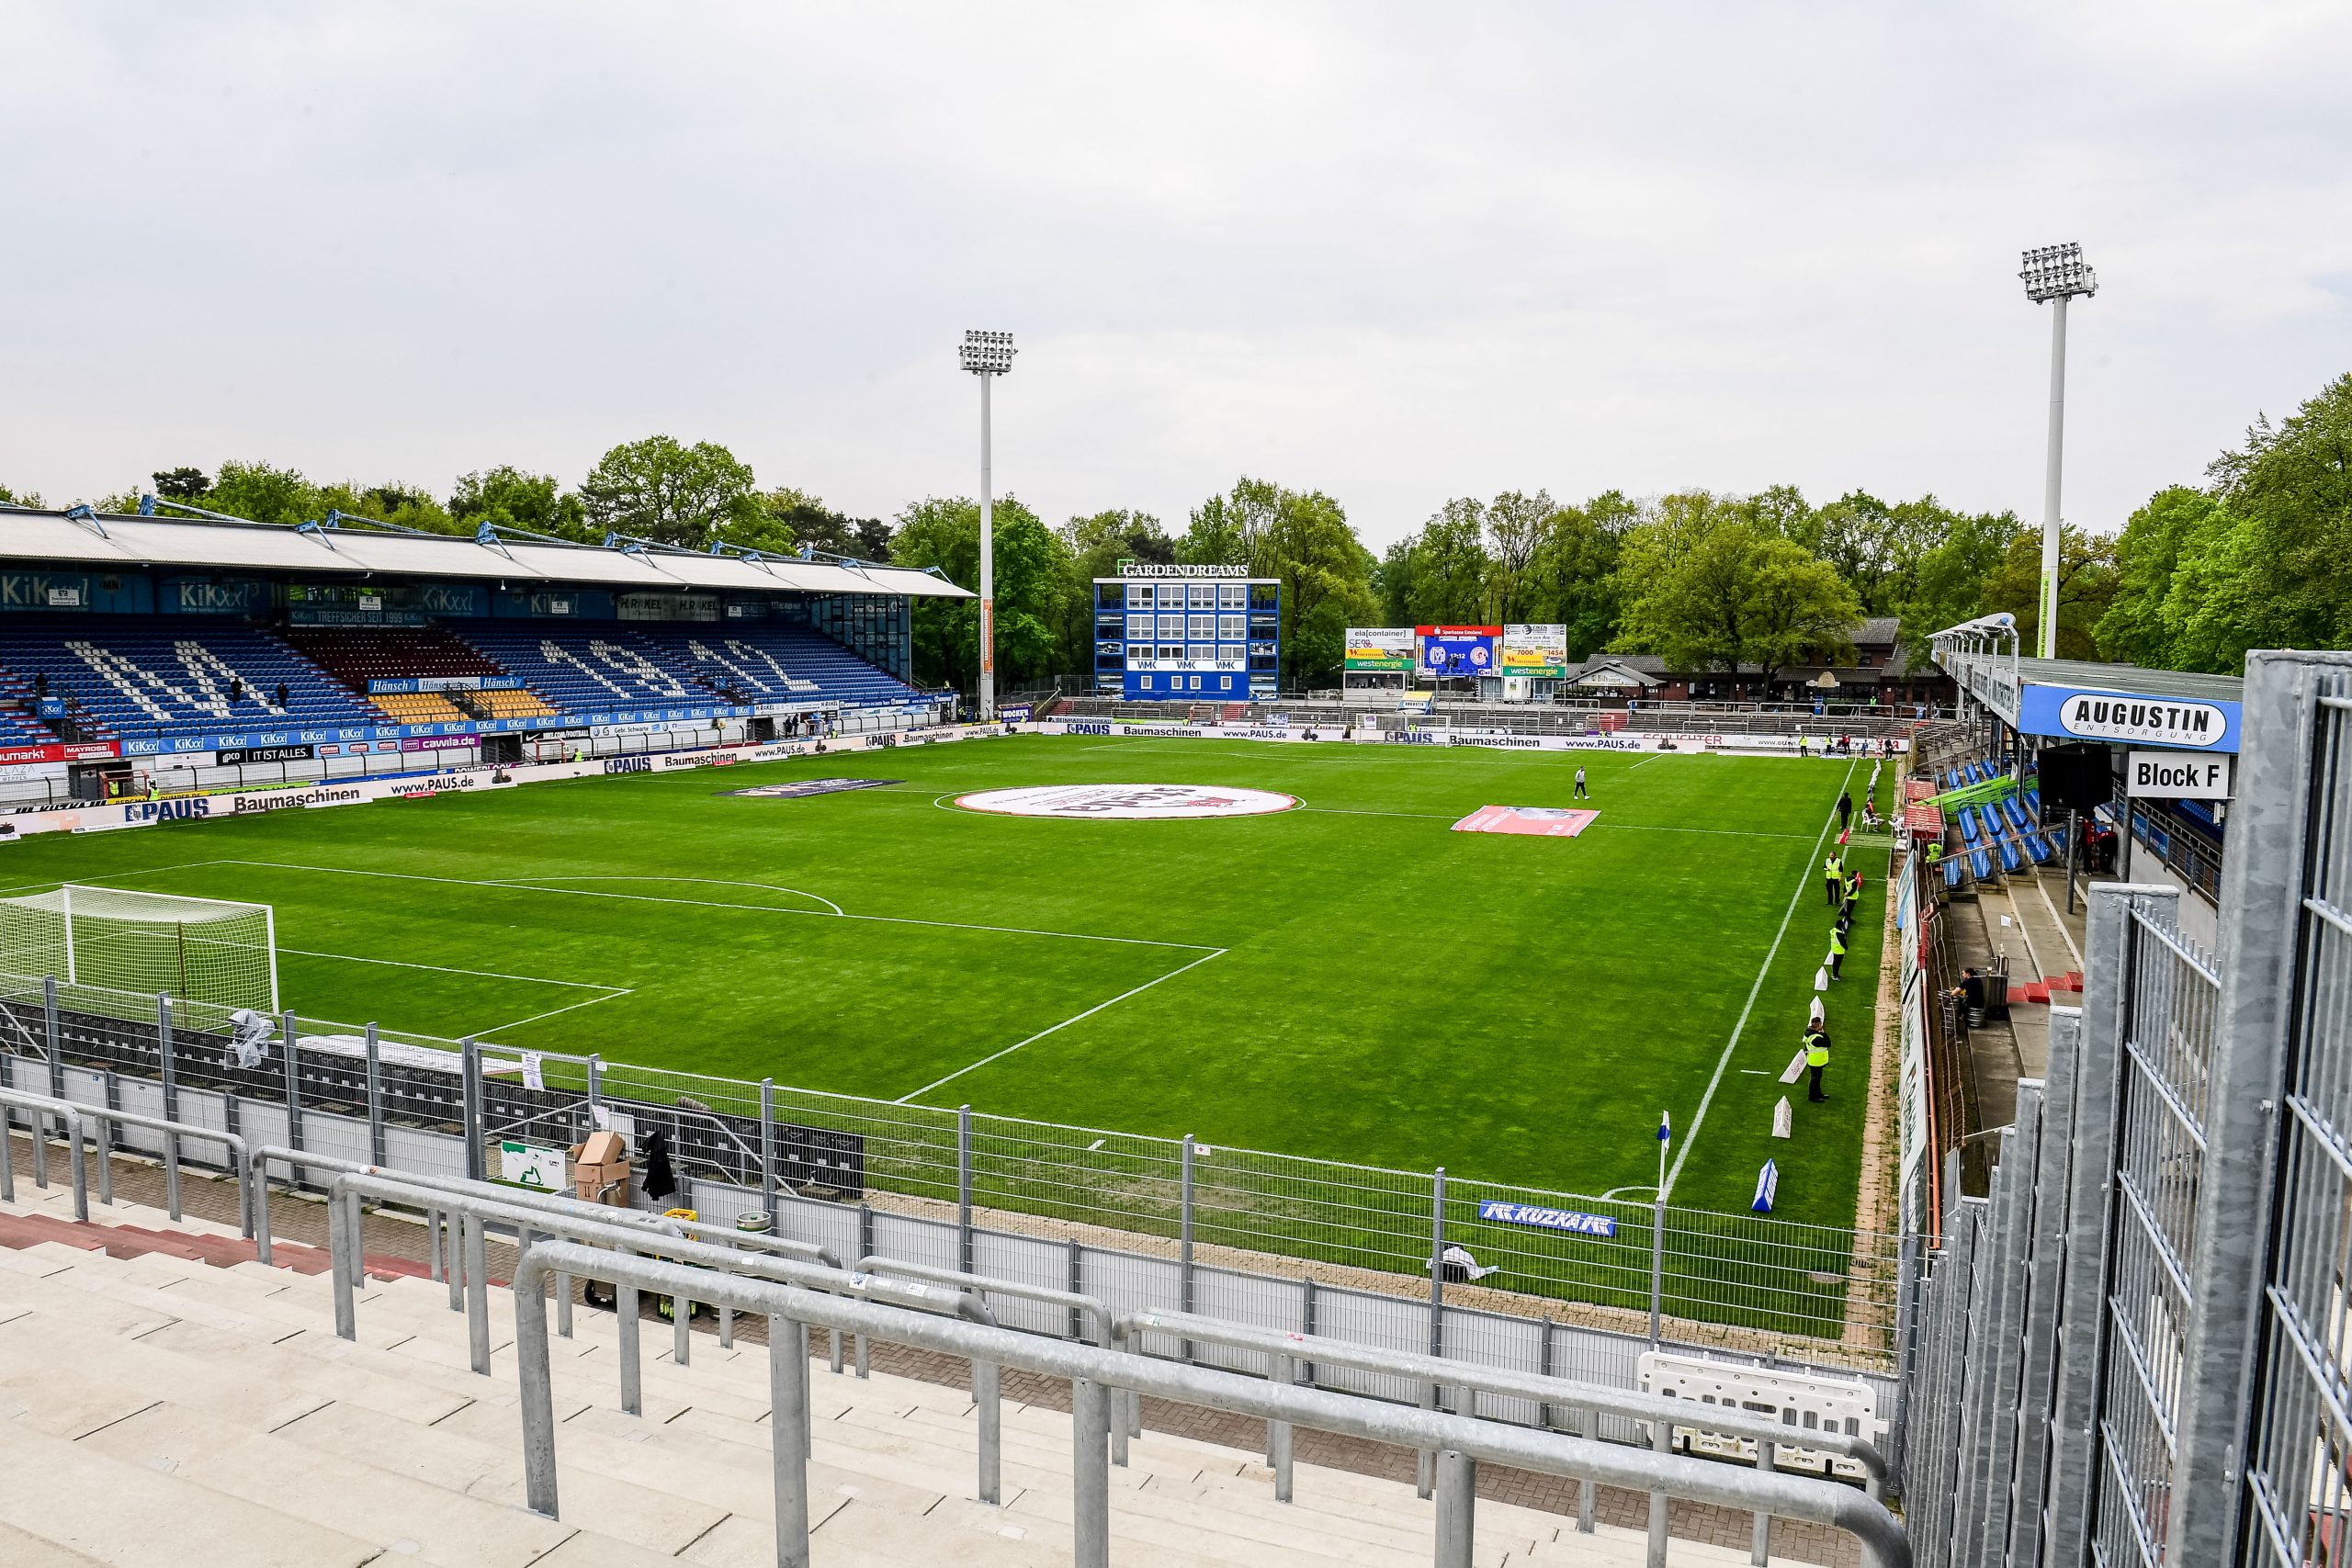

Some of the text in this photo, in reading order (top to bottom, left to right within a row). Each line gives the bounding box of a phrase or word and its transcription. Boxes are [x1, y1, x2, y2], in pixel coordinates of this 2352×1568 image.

[1123, 564, 1250, 577] GARDENDREAMS
[2, 575, 89, 606] KiKl
[317, 611, 366, 624] TREFFSICHER
[368, 611, 383, 624] SEIT
[385, 612, 403, 624] 1999
[1354, 630, 1407, 638] ela[container]
[1136, 660, 1157, 670] WMK
[1176, 660, 1196, 670] WMK
[1216, 660, 1236, 670] WMK
[1357, 660, 1403, 669] westenergie
[1510, 668, 1559, 677] westenergie
[372, 680, 410, 692] Hänsch
[484, 677, 517, 688] Hänsch
[2075, 700, 2210, 733] AUGUSTIN
[128, 741, 160, 752] KiKxxl
[175, 738, 204, 750] KiKxxl
[219, 736, 247, 747] KiKxxl
[260, 733, 288, 745] KiKxxl
[300, 731, 327, 742] KiKxxl
[339, 728, 364, 739] KiKxxl
[376, 727, 400, 737] KiKxxl
[411, 725, 434, 735] KiKxxl
[445, 723, 466, 732] KiKxxl
[476, 720, 497, 730] KiKxxl
[506, 719, 527, 728] KiKxxl
[536, 717, 557, 727] KiKxxl
[564, 716, 584, 725] KiKxxl
[592, 714, 610, 723] KiKxxl
[965, 726, 999, 737] www.PAUS.de
[1076, 724, 1111, 736] PAUS
[1124, 726, 1202, 737] Baumaschinen
[1223, 729, 1287, 739] www.PAUS.de
[2073, 723, 2208, 742] ENTSORGUNG
[422, 737, 476, 749] cawila.de
[871, 734, 897, 747] PAUS
[903, 732, 954, 743] Baumaschinen
[1395, 732, 1433, 743] PAUS
[1449, 735, 1540, 748] Baumaschinen
[66, 745, 107, 753] MAYROSE
[755, 743, 807, 758] www.PAUS.de
[1566, 739, 1641, 750] www.PAUS.de
[253, 750, 263, 761] IT
[264, 750, 277, 760] IST
[278, 748, 309, 759] ALLES.
[665, 751, 738, 767] Baumaschinen
[614, 757, 651, 773] PAUS
[2137, 762, 2220, 787] Block F
[391, 774, 474, 795] www.PAUS.de
[234, 788, 360, 813] Baumaschinen
[141, 797, 210, 821] PAUS
